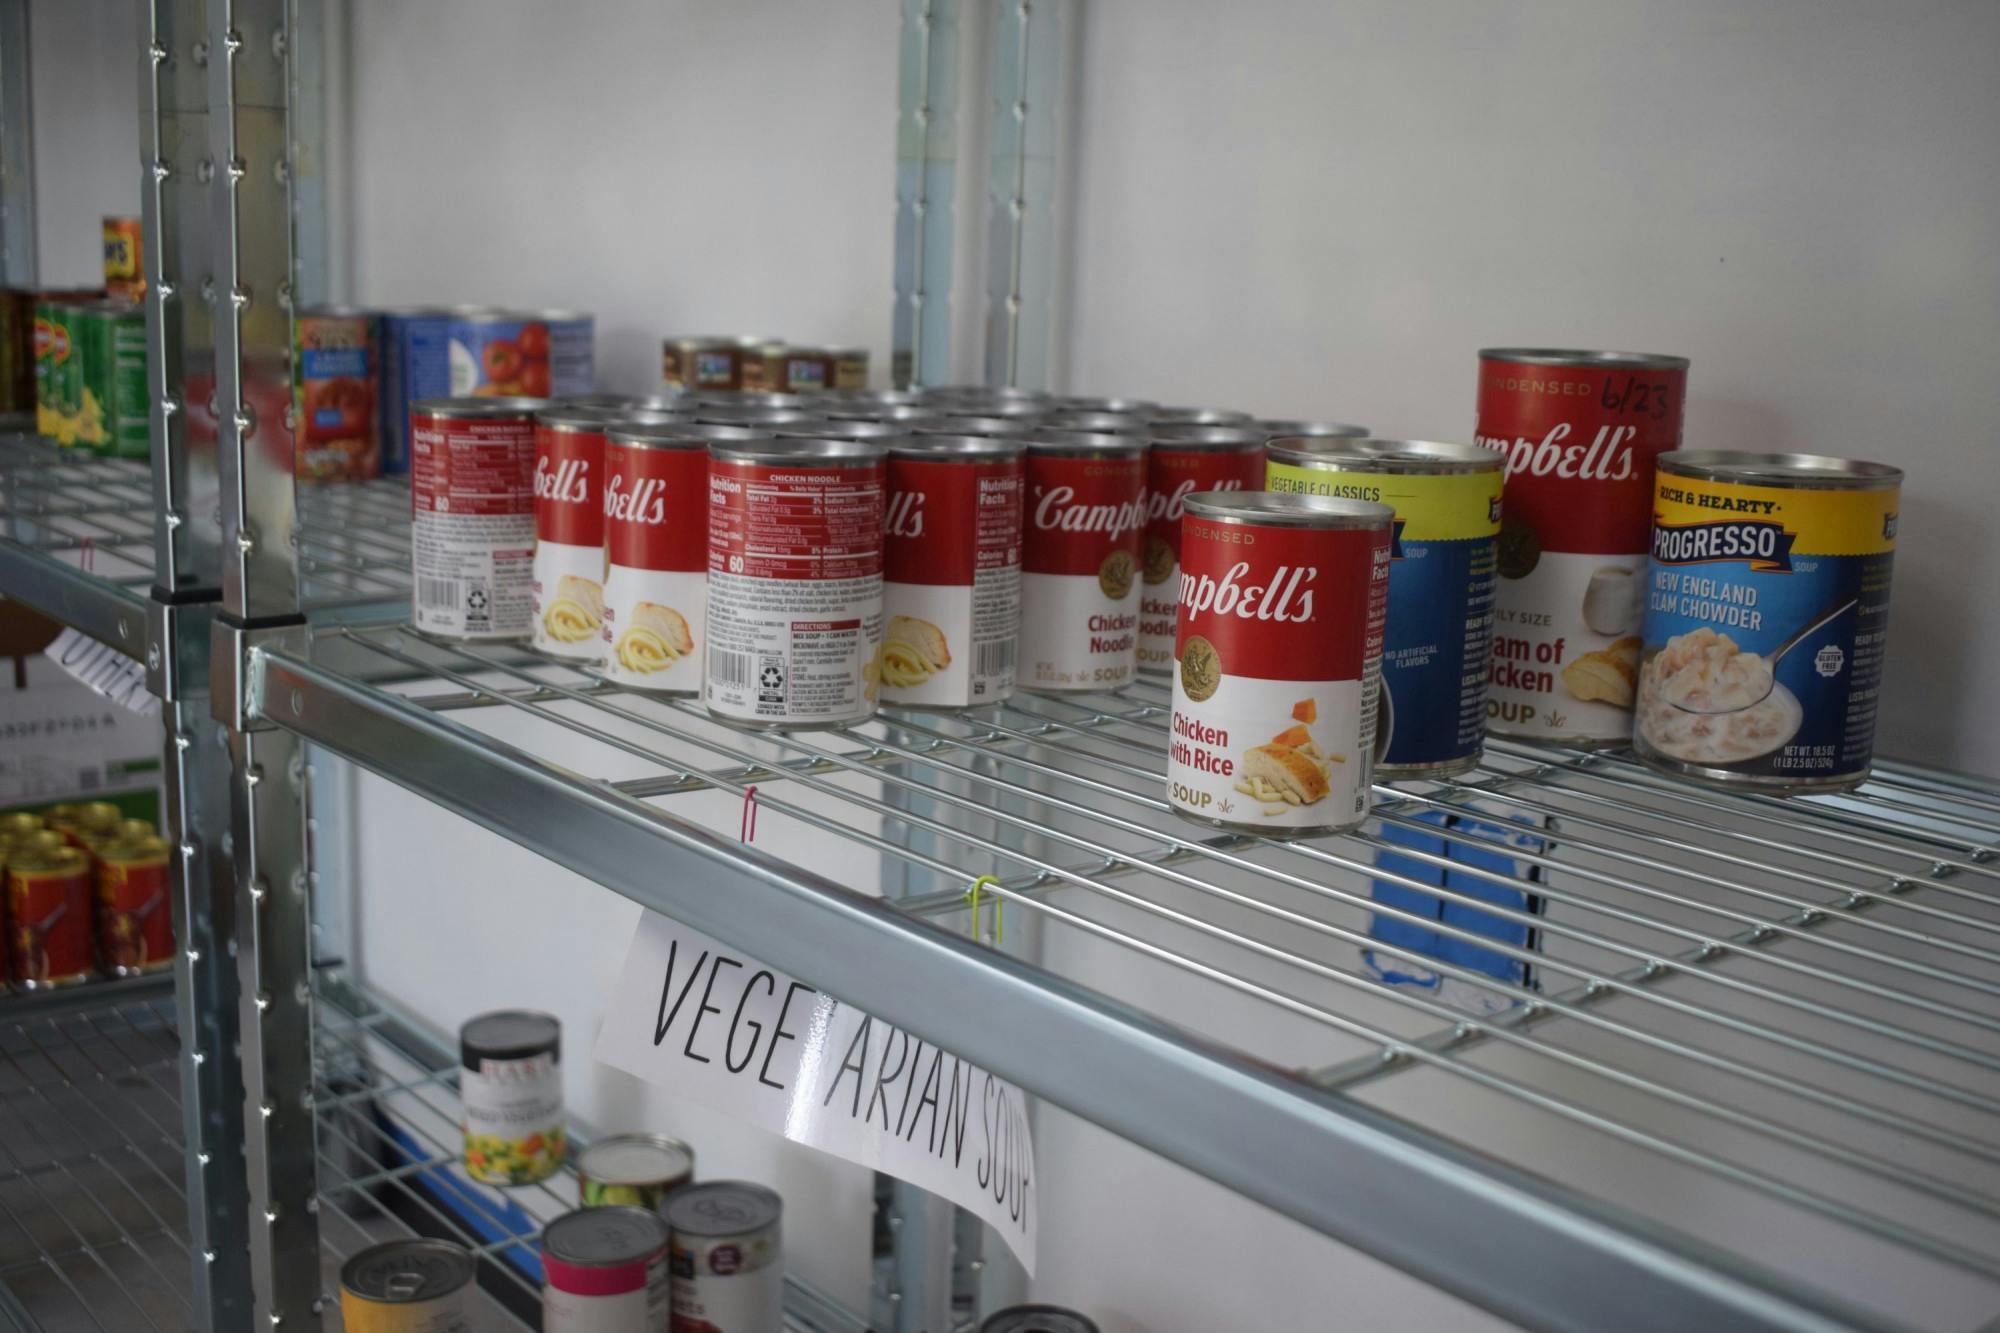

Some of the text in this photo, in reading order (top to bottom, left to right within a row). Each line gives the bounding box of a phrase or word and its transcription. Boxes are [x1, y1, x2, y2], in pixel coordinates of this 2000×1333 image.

[769, 475, 841, 483] CHICKEN NOODLE
[1319, 483, 1380, 502] CLASSICS
[1660, 486, 1776, 514] RICH & HEARTY
[1405, 548, 1428, 559] SOUP
[1654, 526, 1775, 560] PROGRESSO
[729, 555, 744, 573] 60
[1795, 561, 1818, 573] SOUP
[1656, 571, 1757, 607] NEW ENGLAND
[1520, 612, 1552, 626] SIZE
[1680, 597, 1762, 632] CHOWDER
[1397, 645, 1439, 660] ARTIFICIAL
[1536, 638, 1565, 664] of
[1396, 656, 1430, 669] FLAVORS
[1173, 711, 1228, 748] Chicken
[1194, 747, 1234, 777] Rice
[1784, 746, 1798, 756] NET
[1173, 781, 1212, 809] SOUP
[653, 939, 974, 1169] VEGEARIAN
